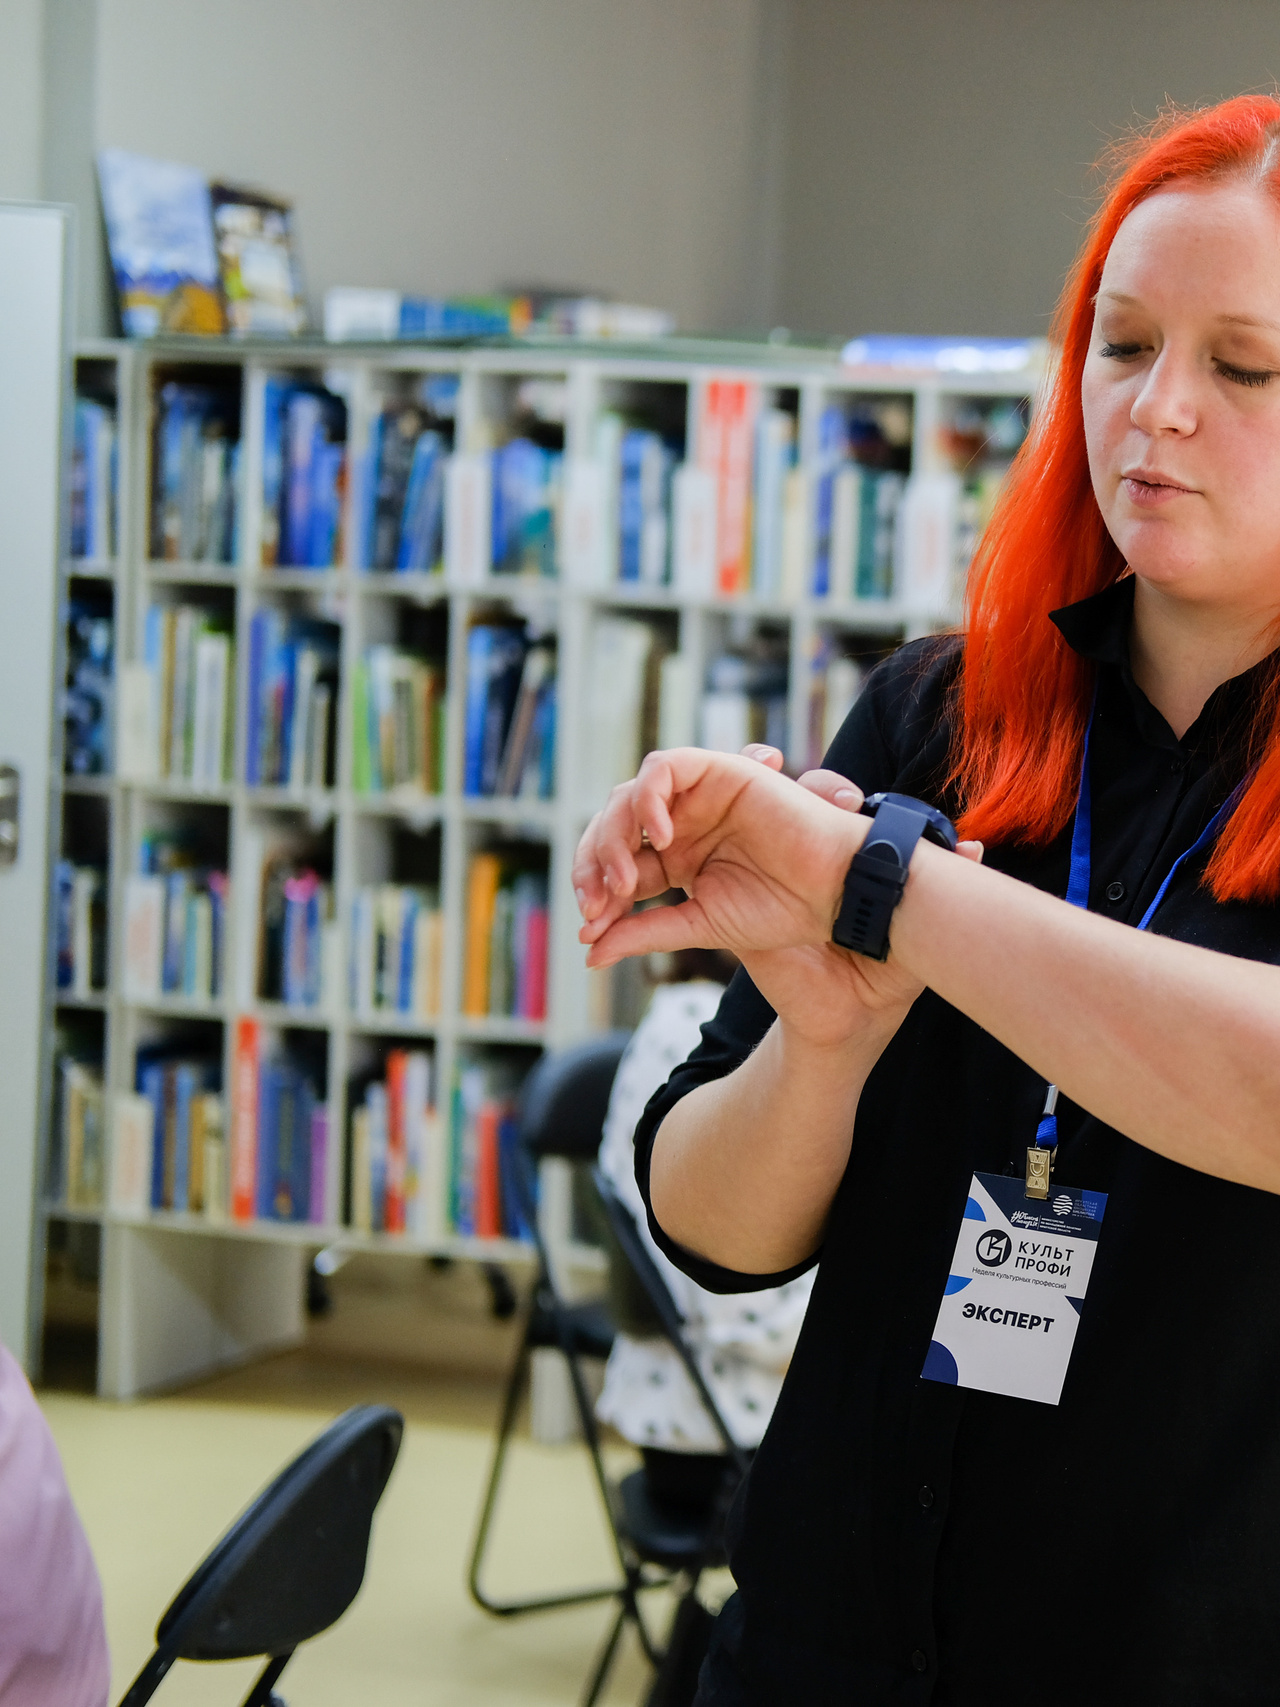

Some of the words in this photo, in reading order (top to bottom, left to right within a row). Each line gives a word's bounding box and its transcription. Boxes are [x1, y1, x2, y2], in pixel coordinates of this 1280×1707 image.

[1018, 1241, 1074, 1261] КУЛЬТ
[1014, 1256, 1071, 1277] ПРОФИ
[972, 1267, 995, 1276] Неделя
[996, 1272, 1031, 1283] культурных
[1031, 1278, 1067, 1290] профессий
[962, 1303, 1055, 1333] ЭКСПЕРТ
